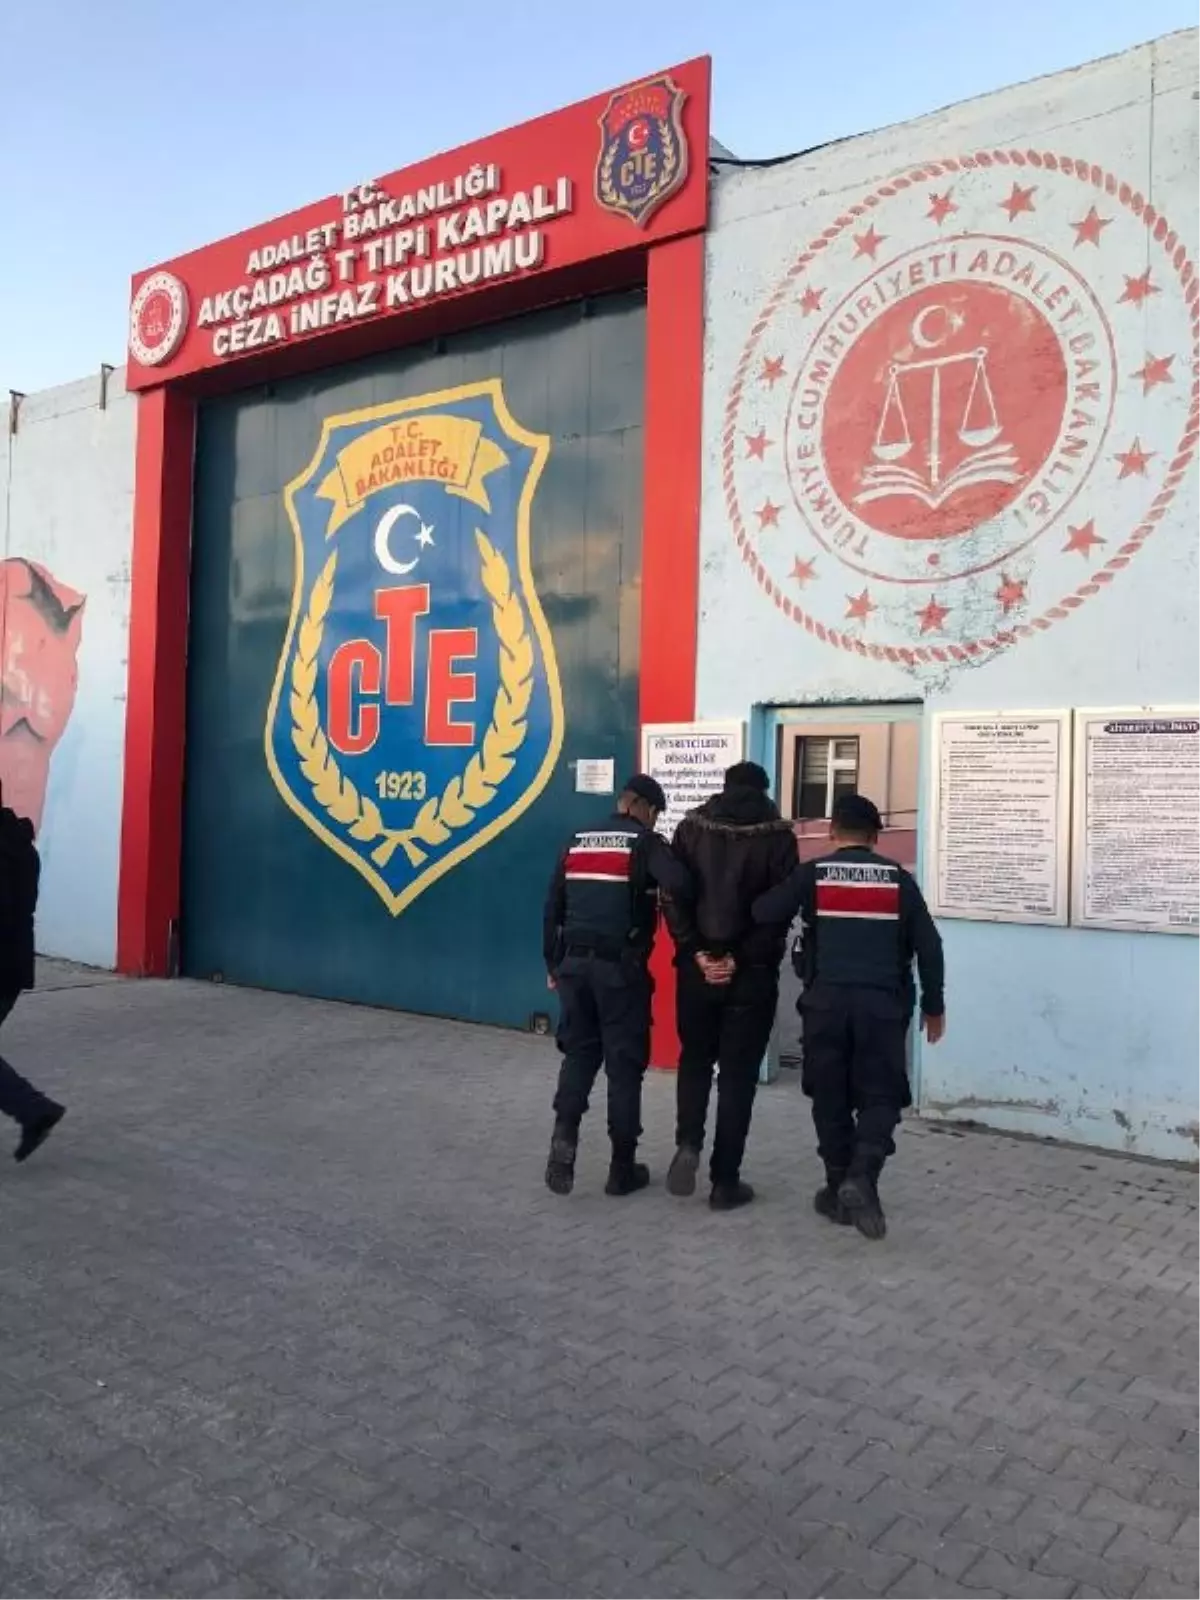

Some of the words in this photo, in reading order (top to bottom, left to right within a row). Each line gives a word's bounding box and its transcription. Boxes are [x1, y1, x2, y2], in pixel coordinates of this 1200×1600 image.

[620, 147, 657, 187] CTE
[197, 253, 330, 327] AKÇADAĞ
[335, 249, 357, 282] T
[437, 176, 573, 251] KAPALI
[246, 221, 337, 275] ADALET
[343, 163, 500, 241] BAKANLIĞI
[212, 312, 287, 357] CEZA
[387, 230, 544, 308] KURUMU
[388, 420, 424, 444] T.C.
[797, 443, 869, 558] TÜRKİYE
[968, 250, 1083, 323] ADALET
[371, 439, 442, 470] ADALET
[327, 583, 478, 755] CTE
[375, 770, 426, 800] 1923
[822, 866, 891, 883] JANDARMA
